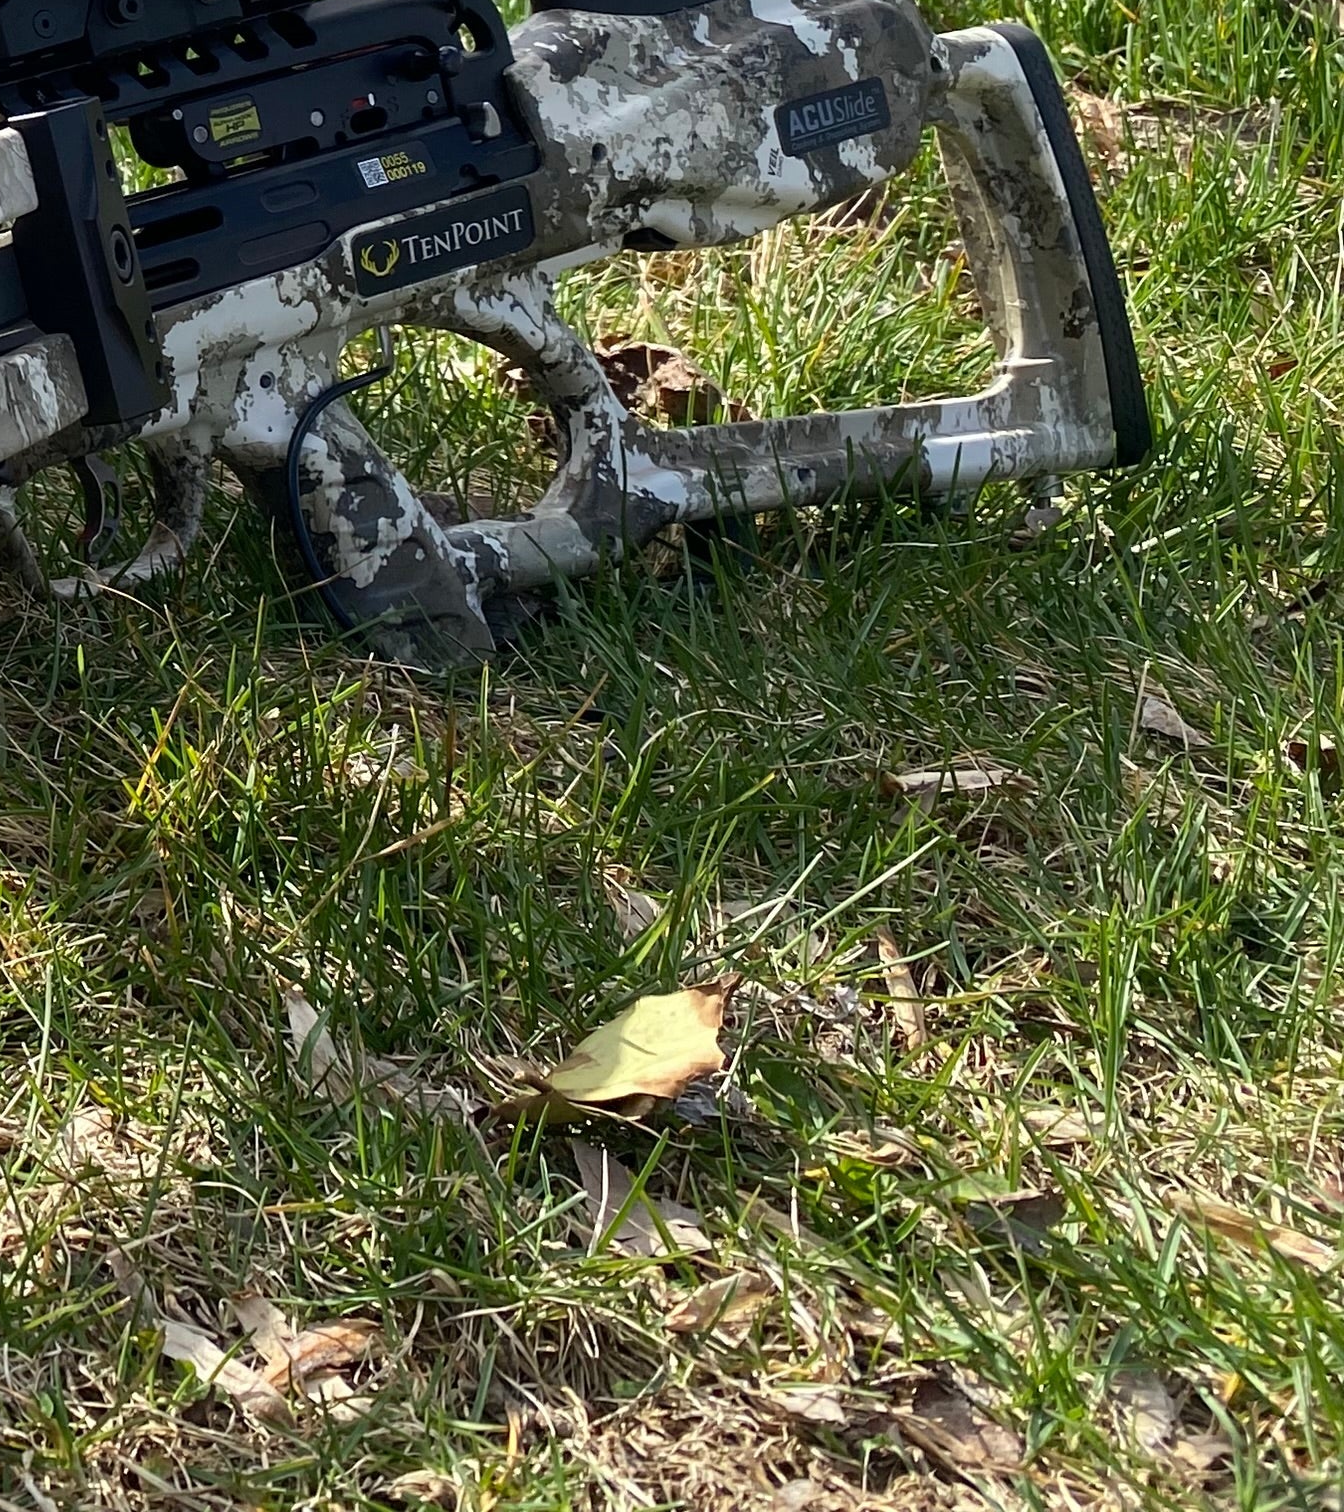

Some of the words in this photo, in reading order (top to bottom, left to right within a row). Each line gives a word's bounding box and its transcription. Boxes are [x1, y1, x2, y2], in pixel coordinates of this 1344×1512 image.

[381, 151, 410, 169] 0055
[768, 147, 780, 176] VEIL
[387, 161, 426, 181] 000119
